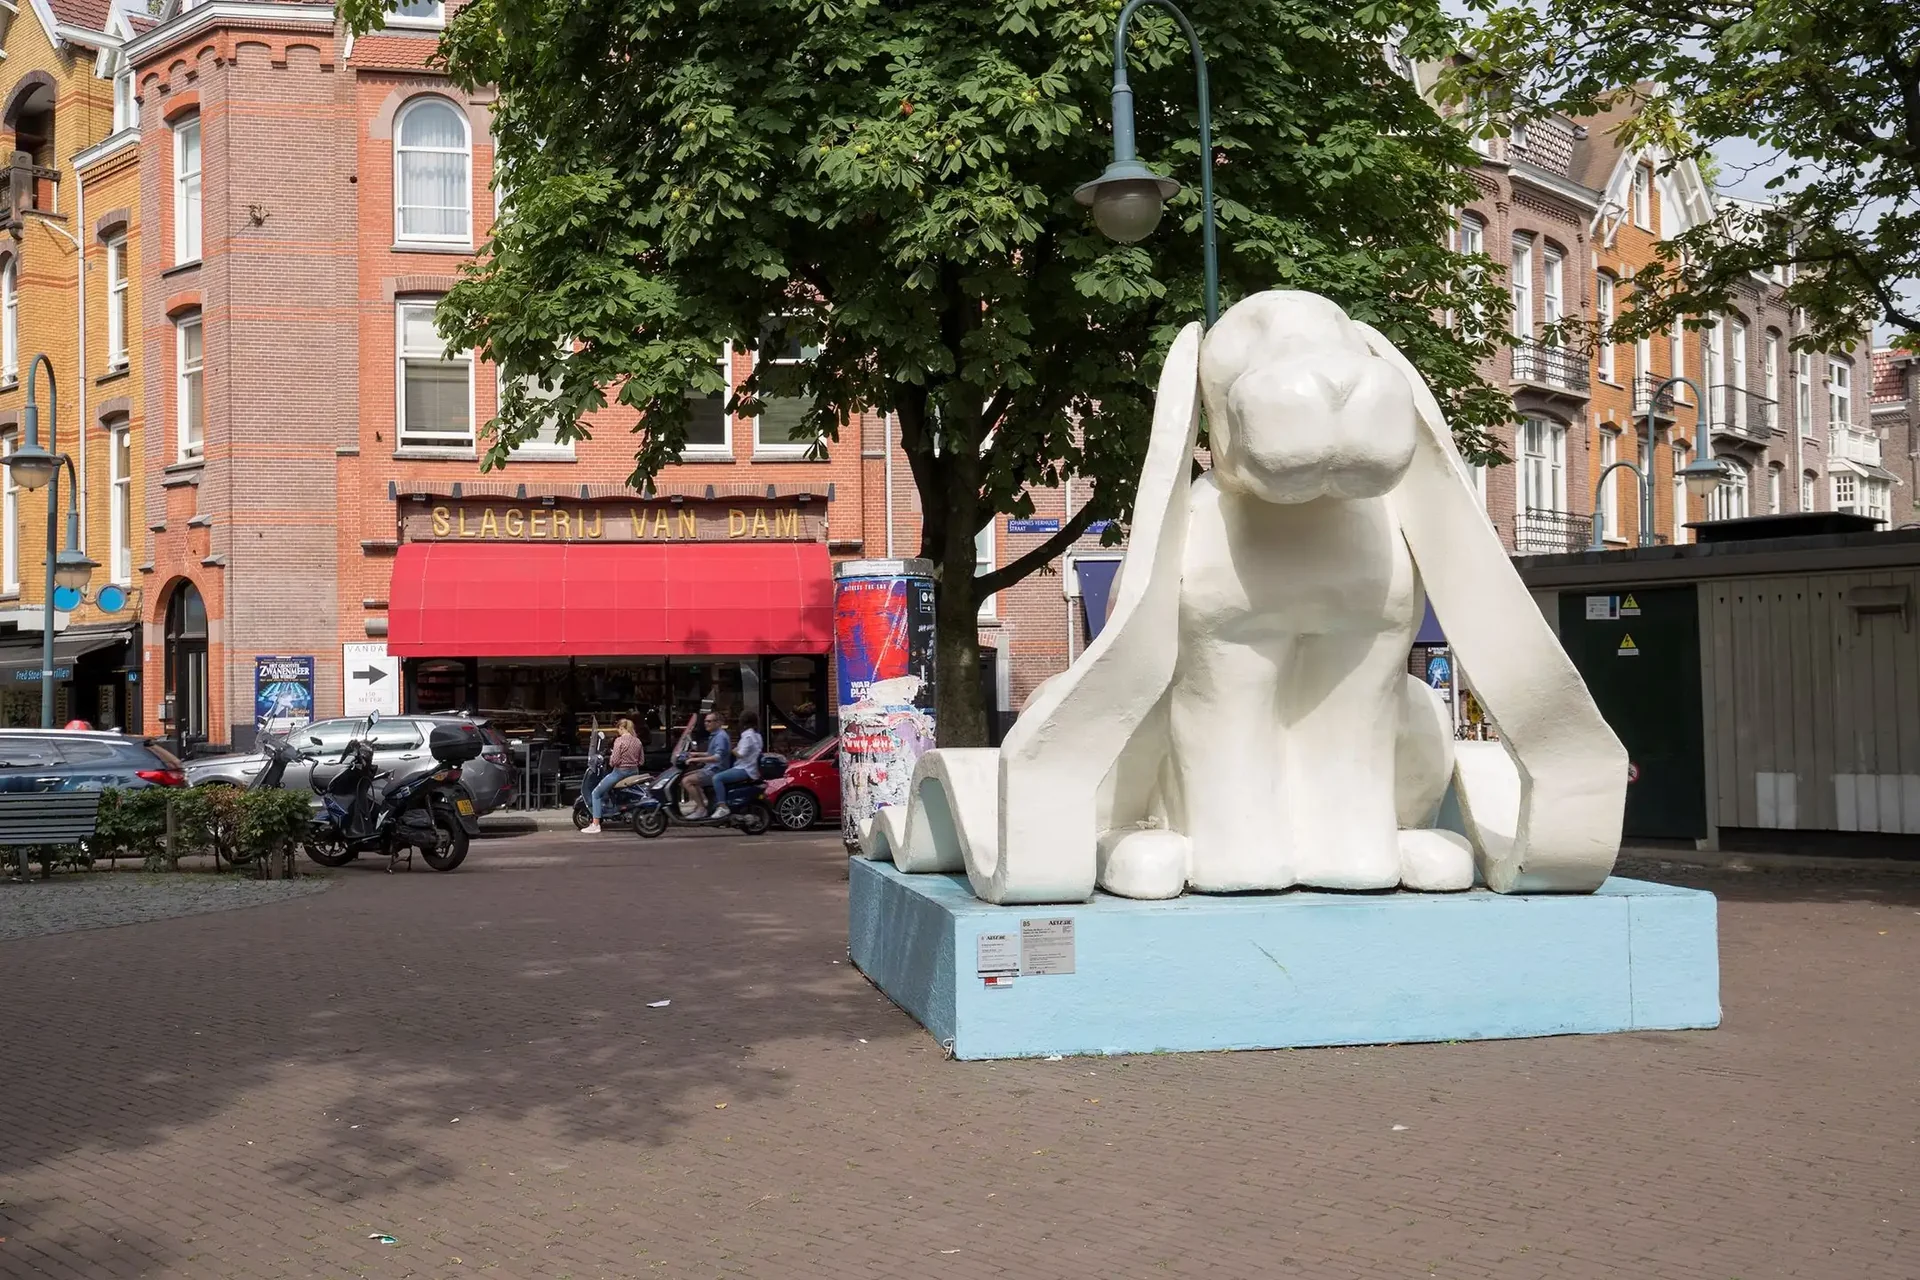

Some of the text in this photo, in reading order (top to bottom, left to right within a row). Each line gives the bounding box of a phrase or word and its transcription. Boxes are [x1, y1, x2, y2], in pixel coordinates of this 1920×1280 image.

[432, 506, 798, 538] SLAGERIJ VAN DAM
[850, 681, 870, 689] WAR
